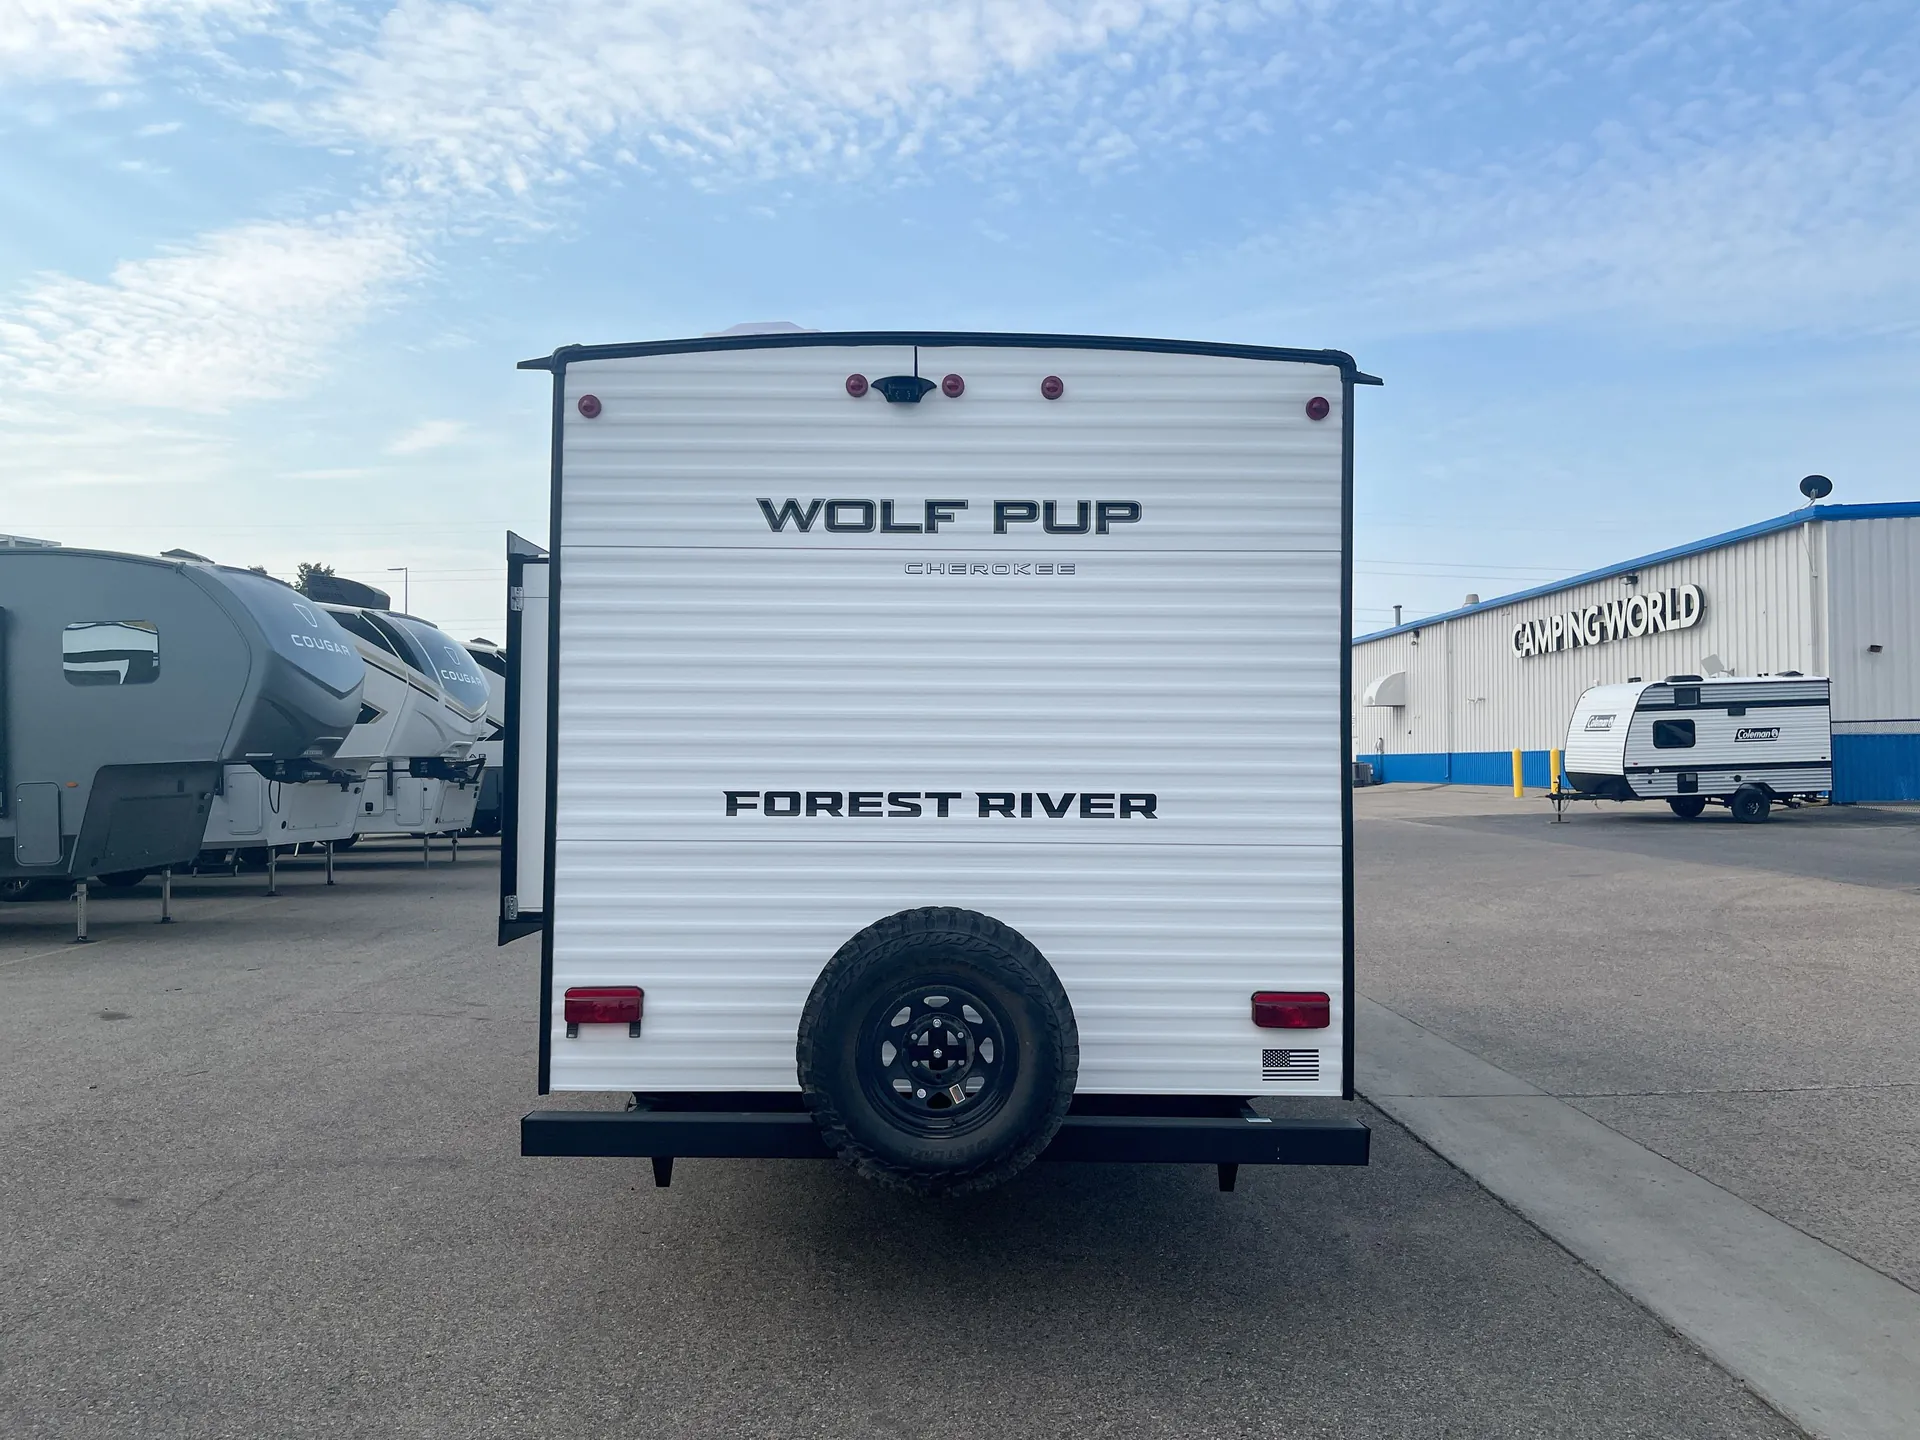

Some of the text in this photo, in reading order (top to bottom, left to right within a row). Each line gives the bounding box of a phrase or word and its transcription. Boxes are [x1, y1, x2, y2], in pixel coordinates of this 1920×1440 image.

[756, 498, 1142, 534] WOLF PUP
[904, 562, 1076, 575] CHEROKEE
[1512, 584, 1704, 658] CAMPING WORLD
[291, 634, 351, 657] COUGAR
[441, 670, 483, 686] COUGAR
[1737, 729, 1771, 739] Coleman
[722, 791, 1158, 819] FOREST RIVER
